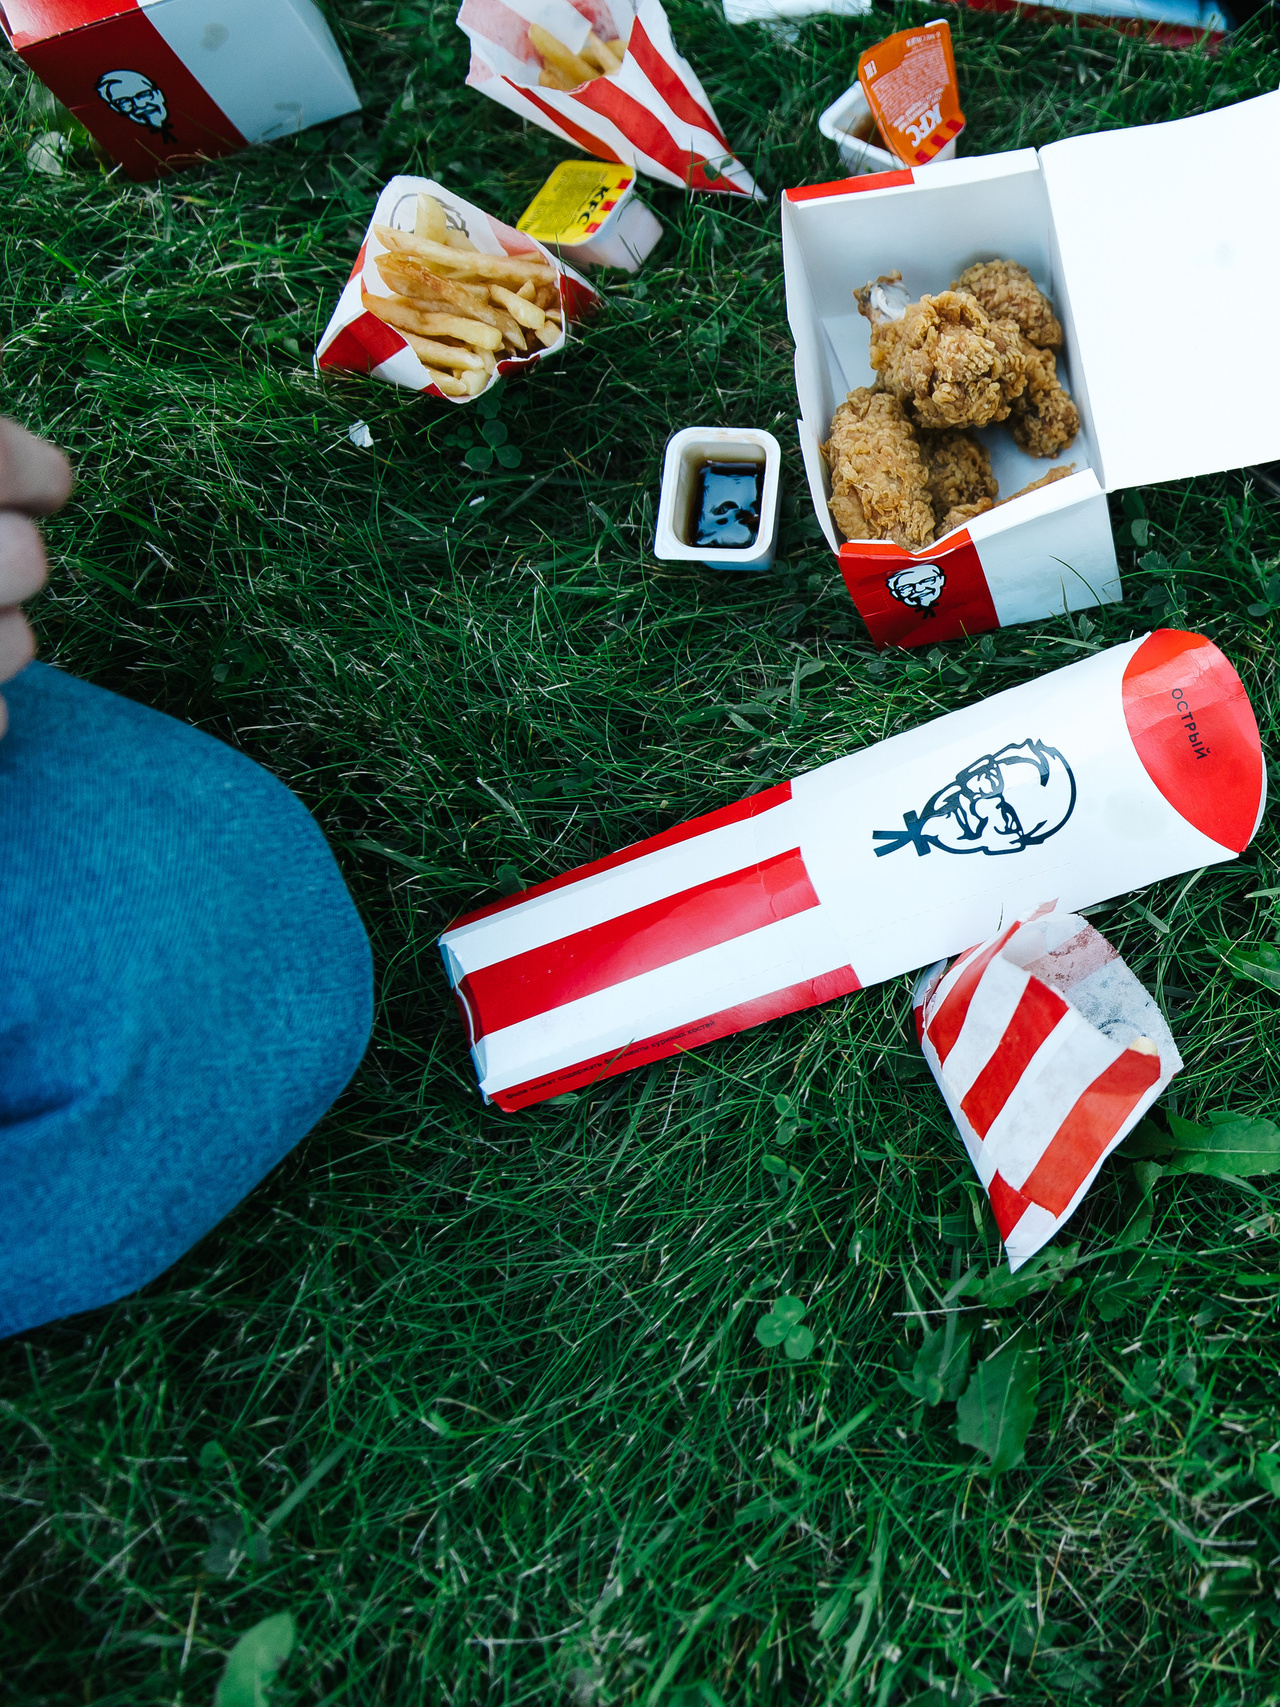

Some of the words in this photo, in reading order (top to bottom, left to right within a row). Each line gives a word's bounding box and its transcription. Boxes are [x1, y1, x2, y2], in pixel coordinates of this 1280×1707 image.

[905, 101, 943, 148] KFC
[577, 185, 611, 225] KFC
[1171, 688, 1211, 760] ОСТРЫЙ
[505, 1088, 529, 1100] Филе
[530, 1079, 556, 1091] может
[557, 1062, 603, 1081] содержать
[651, 1032, 687, 1048] куриных
[687, 1019, 716, 1034] костей
